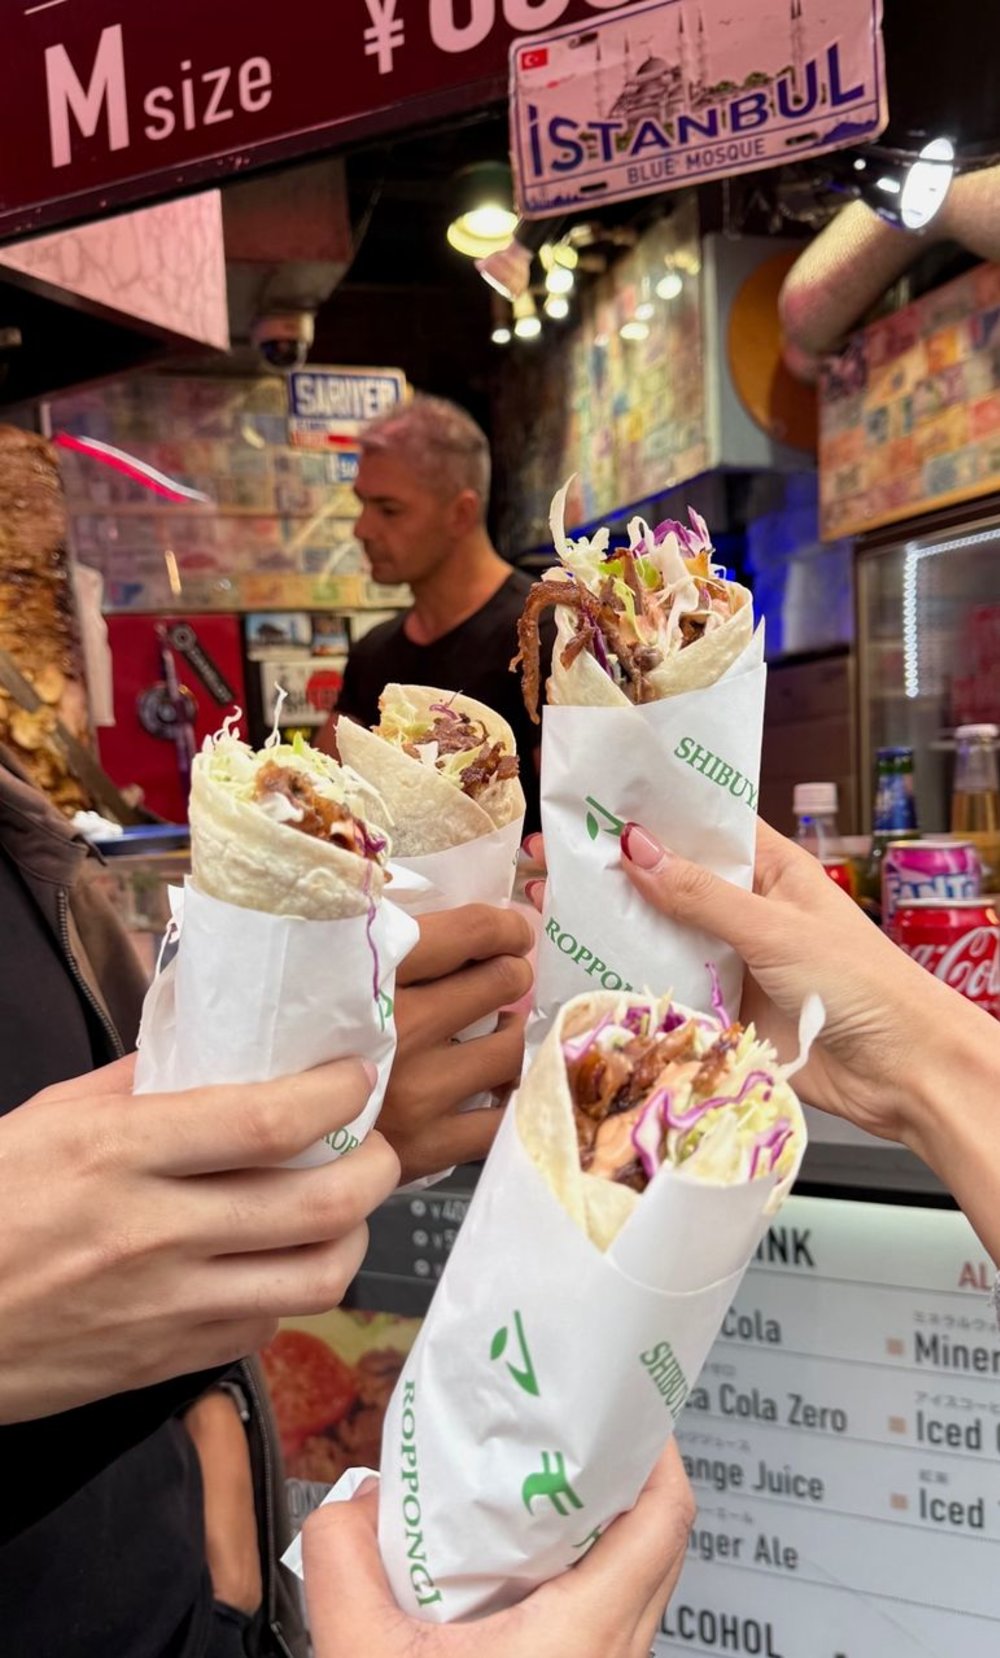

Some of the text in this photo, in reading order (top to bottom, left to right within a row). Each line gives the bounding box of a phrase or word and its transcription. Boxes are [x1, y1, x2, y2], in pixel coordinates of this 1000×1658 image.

[45, 24, 272, 168] M size
[627, 138, 766, 185] BLUE MOSQUE
[673, 737, 758, 811] SHIBUY
[545, 917, 634, 993] ROPPO
[756, 1226, 814, 1267] INK
[958, 1261, 993, 1291] AL
[721, 1306, 781, 1342] Cola
[915, 1331, 1000, 1374] Miner
[719, 1383, 777, 1422] Cola
[787, 1392, 848, 1432] Zero
[916, 1410, 981, 1450] Iced
[401, 1381, 442, 1608] ROPPONGI
[682, 1454, 824, 1500] ange Juice
[919, 1487, 984, 1529] Iced
[690, 1528, 798, 1569] nger Ale
[660, 1604, 784, 1658] LCOHOL
